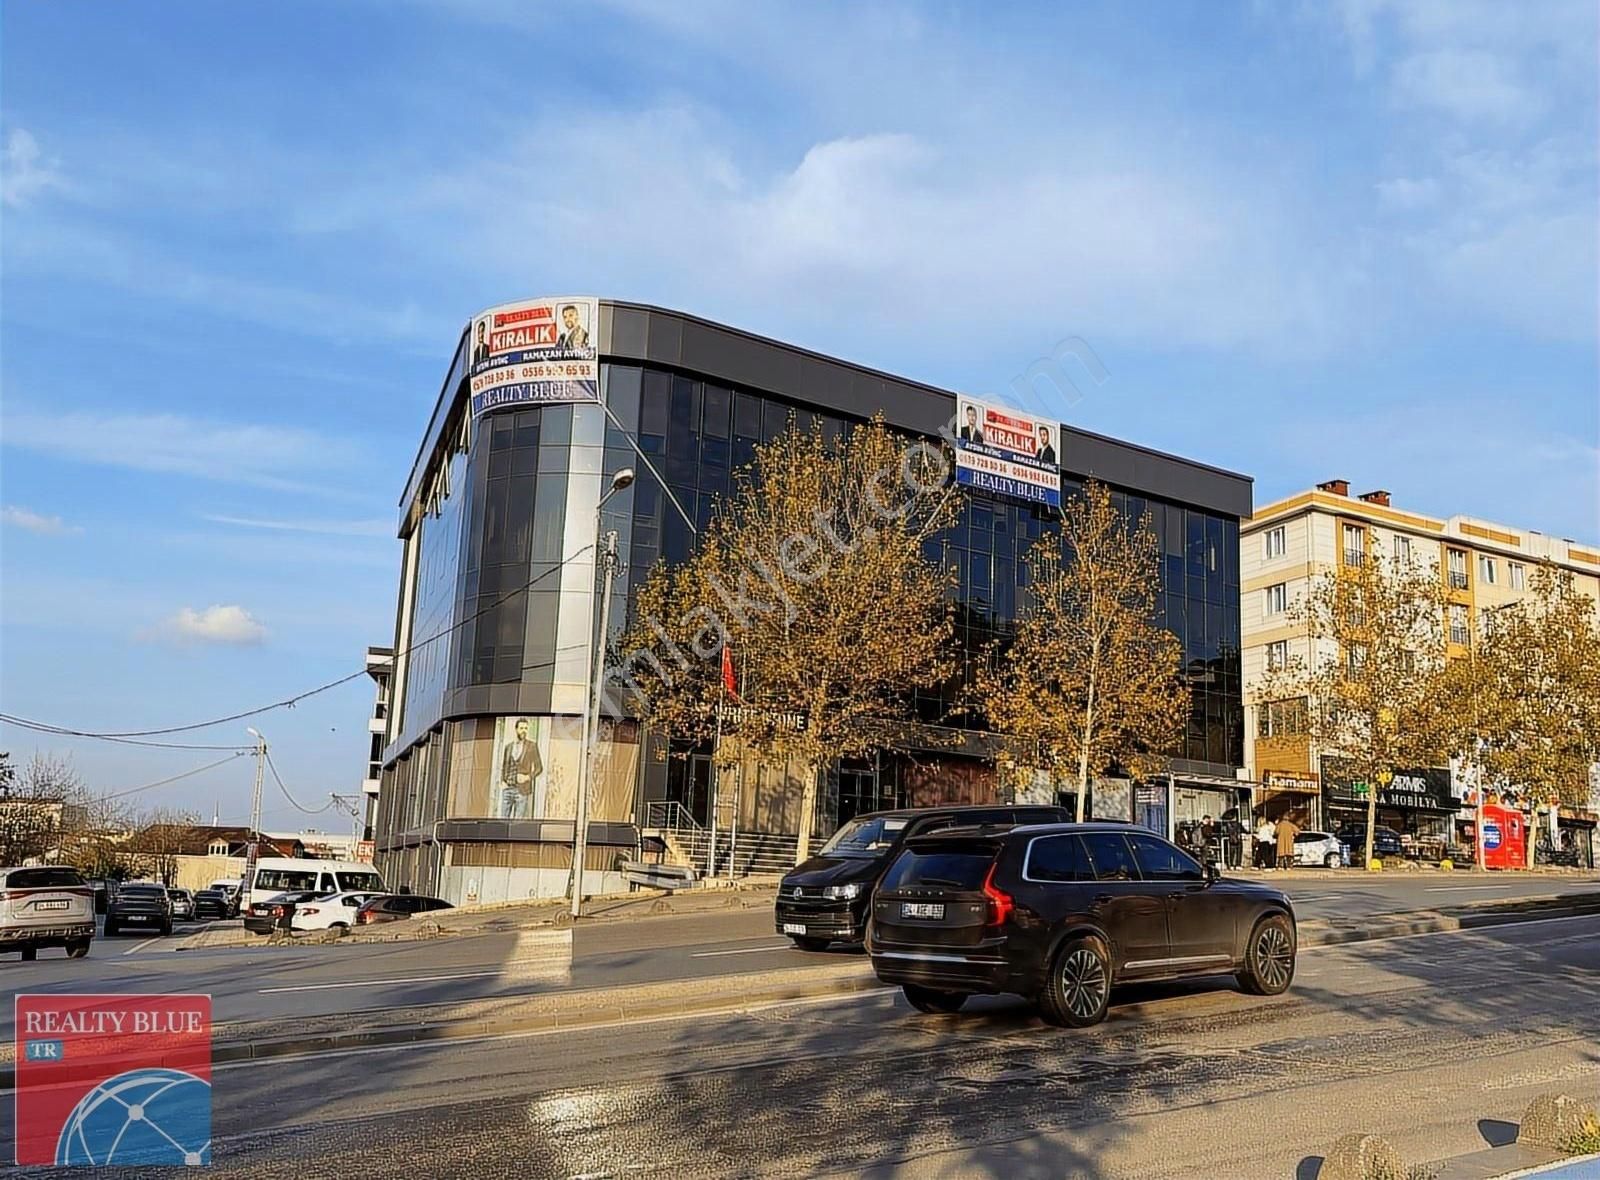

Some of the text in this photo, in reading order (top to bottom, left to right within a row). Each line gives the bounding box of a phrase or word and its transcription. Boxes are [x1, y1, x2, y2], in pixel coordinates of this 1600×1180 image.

[480, 382, 573, 407] REALTY BLUE
[973, 470, 1046, 501] REALTY BLUE
